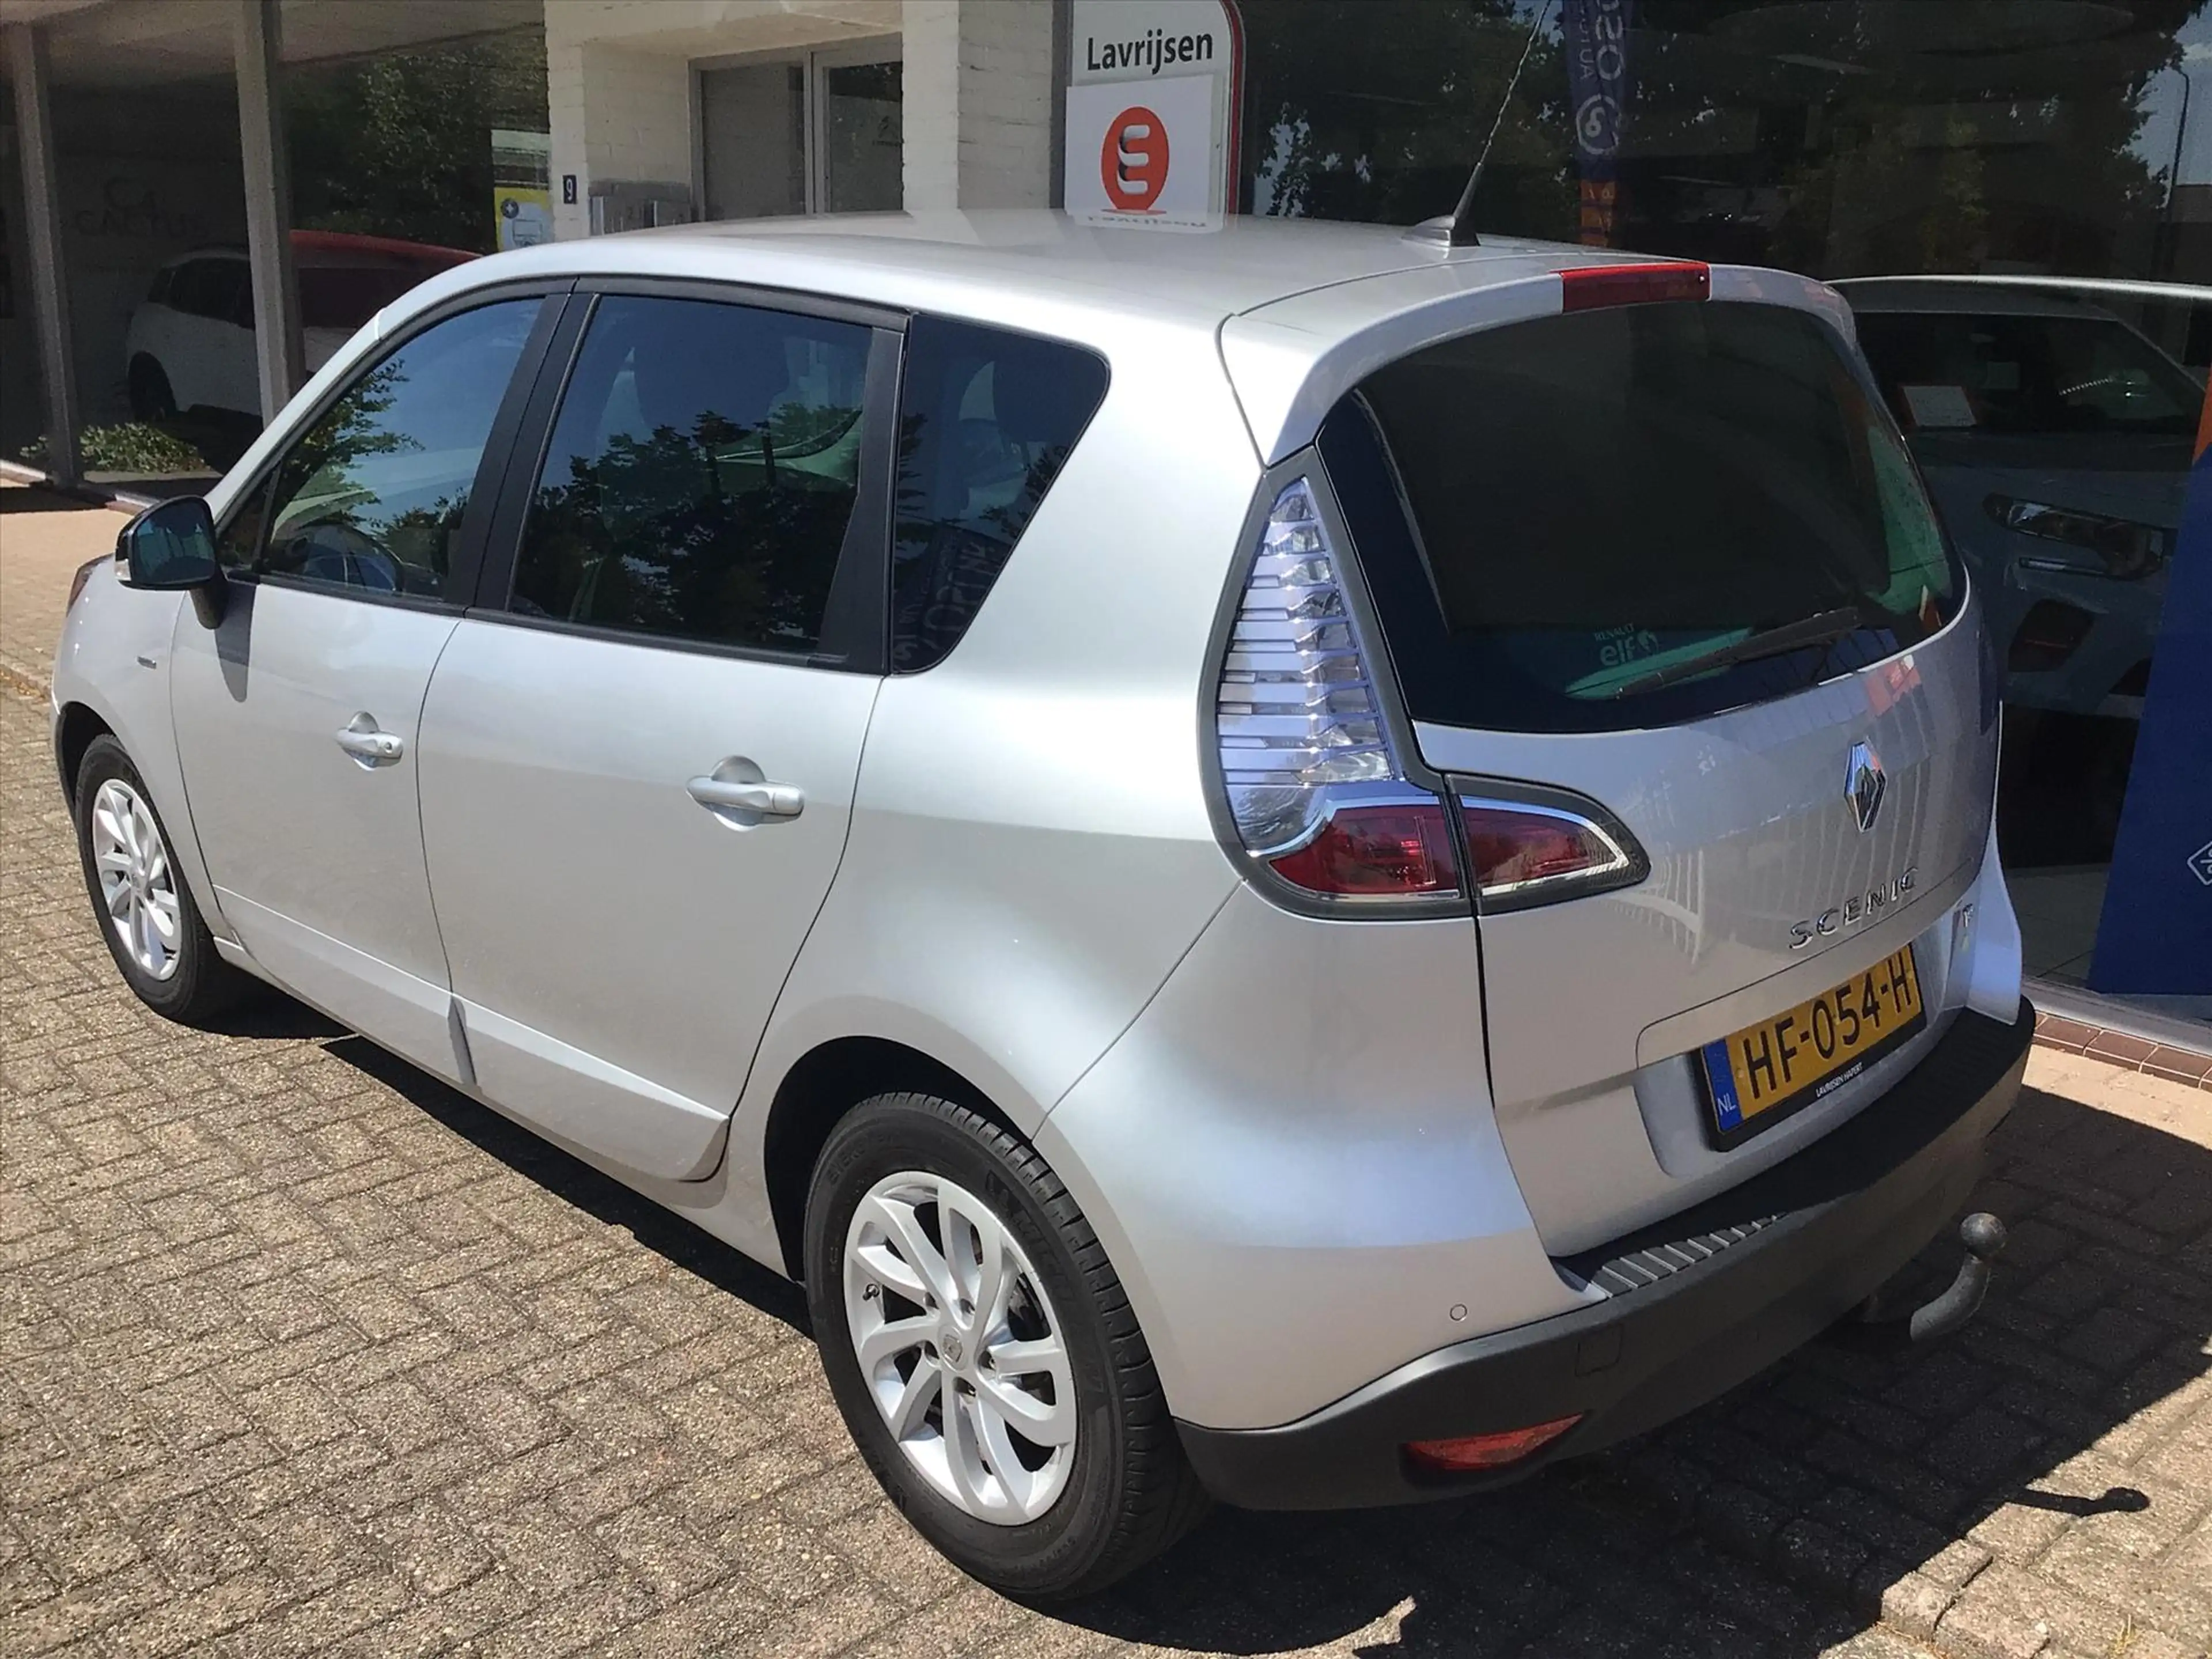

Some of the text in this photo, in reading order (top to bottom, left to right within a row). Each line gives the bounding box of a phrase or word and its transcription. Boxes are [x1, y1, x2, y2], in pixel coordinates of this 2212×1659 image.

[1088, 28, 1213, 75] Lavrijsen
[566, 179, 573, 201] 9
[1600, 636, 1636, 666] elf
[1789, 866, 1919, 950] SCENIC
[1742, 952, 1911, 1100] HF-054-H
[1717, 1092, 1737, 1116] NL
